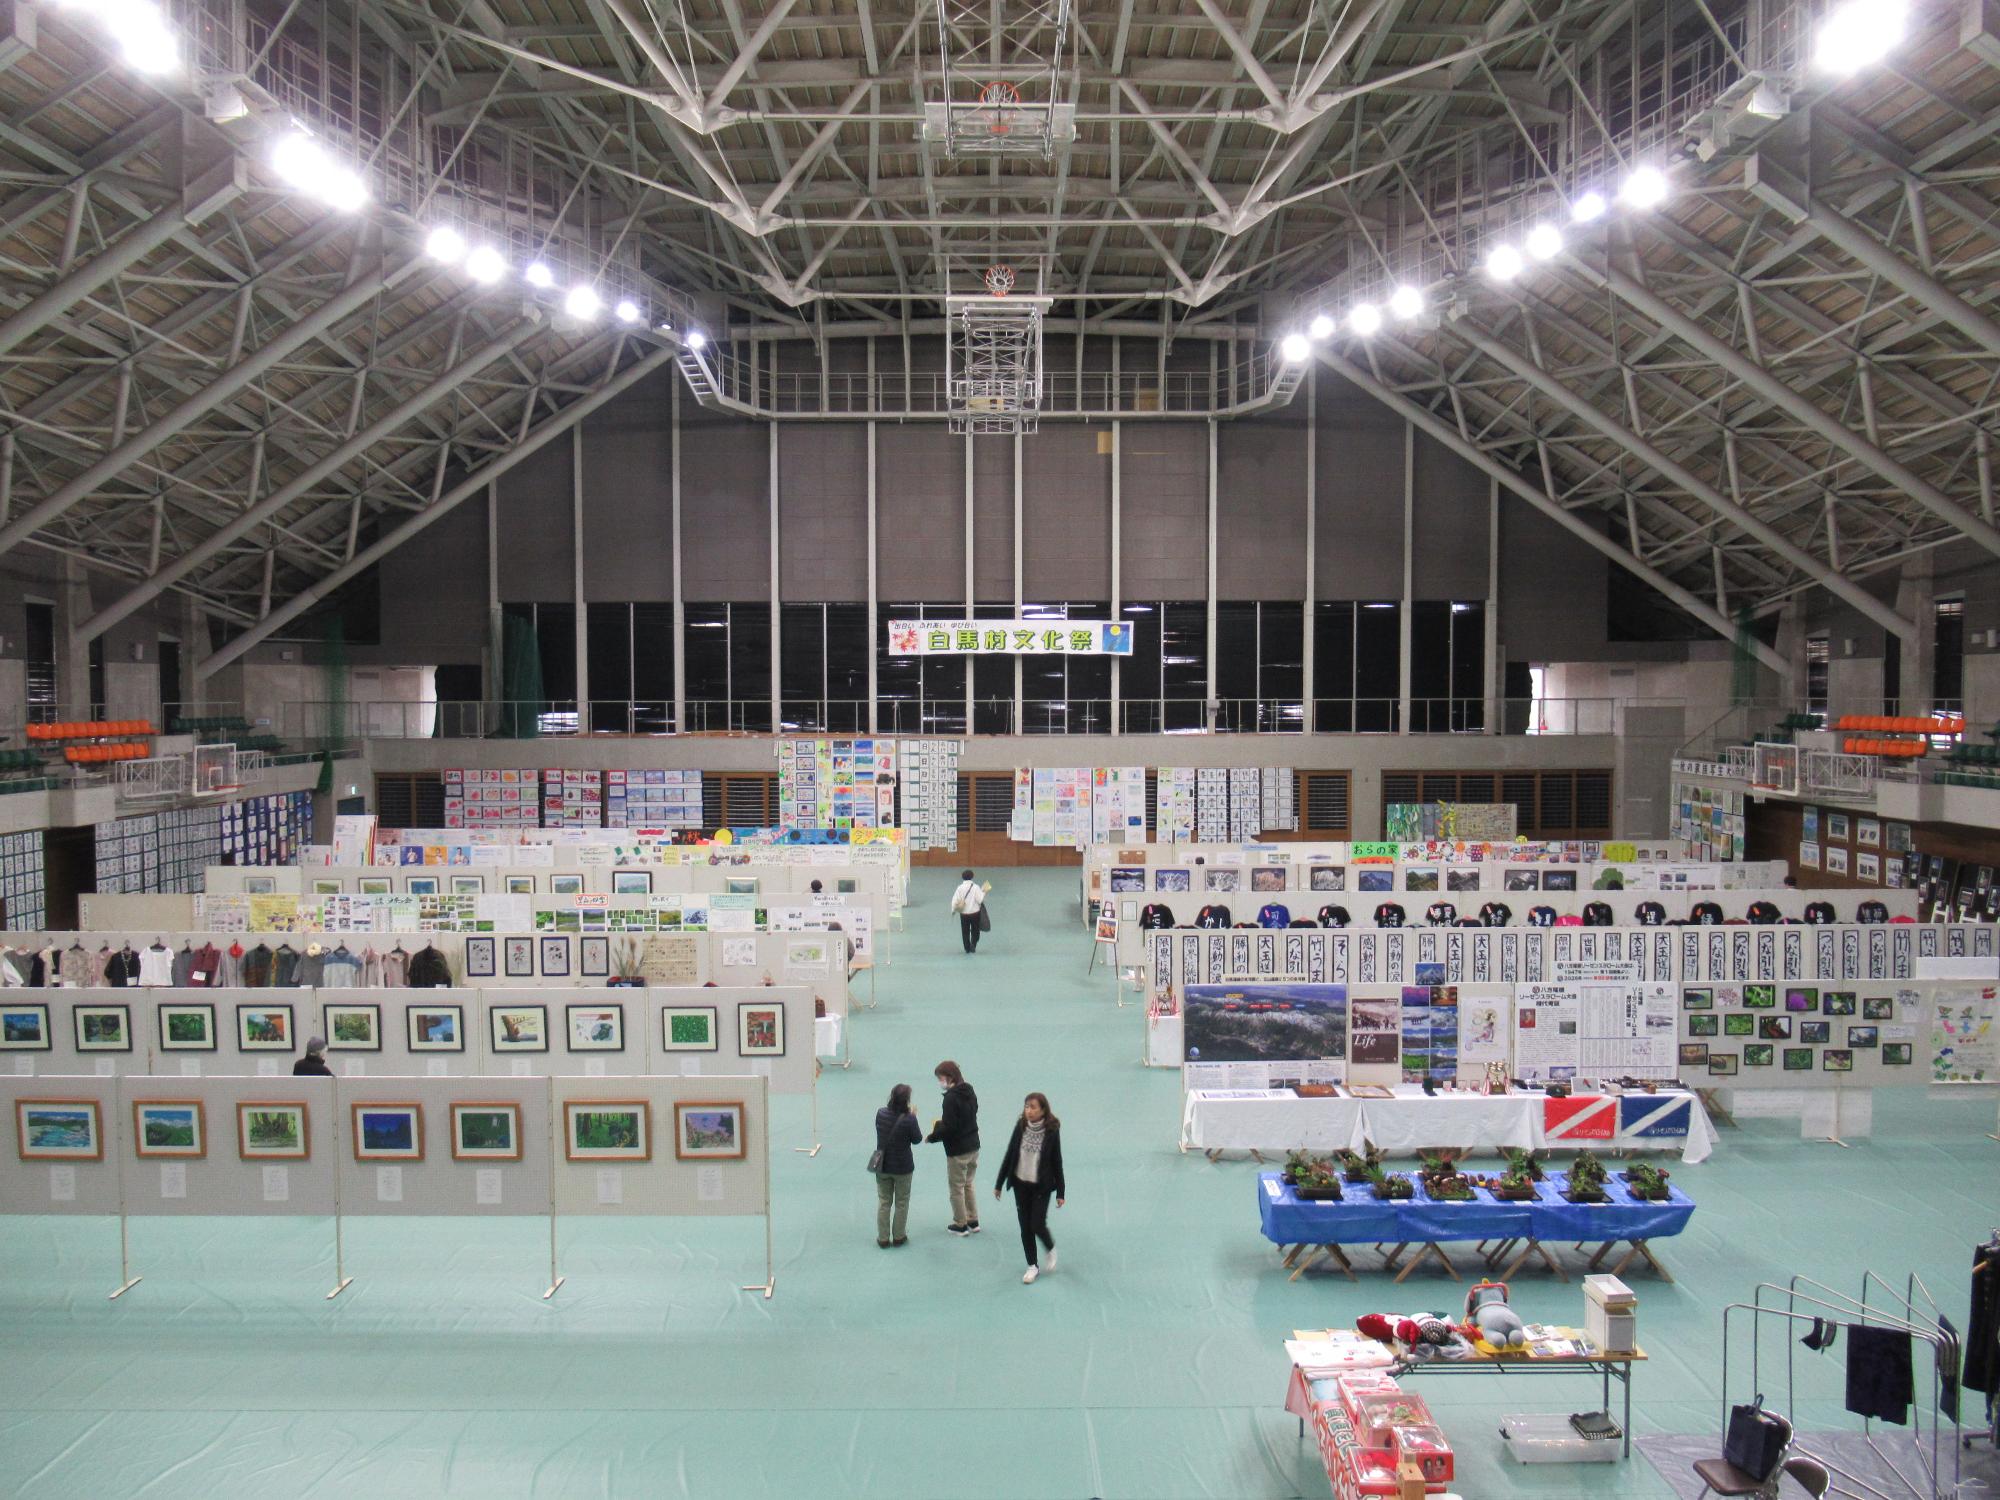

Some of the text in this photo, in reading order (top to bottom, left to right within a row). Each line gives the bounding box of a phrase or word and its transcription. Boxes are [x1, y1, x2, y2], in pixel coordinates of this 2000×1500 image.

[927, 630, 1093, 651] 白馬村文化祭
[1353, 844, 1399, 855] おらの家
[1311, 938, 1322, 982] 竹うま
[1335, 940, 1346, 979] そら
[1450, 935, 1460, 982] 大玉送り
[1477, 936, 1487, 982] 大玉送り
[1657, 934, 1668, 980] 大玉送り
[1711, 934, 1722, 980] つな引き
[1736, 934, 1747, 979] つな引き
[1760, 934, 1772, 978] つな引き
[1786, 933, 1798, 978] つな引き
[1820, 935, 1832, 979] つな引き
[1844, 935, 1856, 978] つな引き
[1872, 932, 1884, 978] つな引き
[1354, 1034, 1377, 1049] Life
